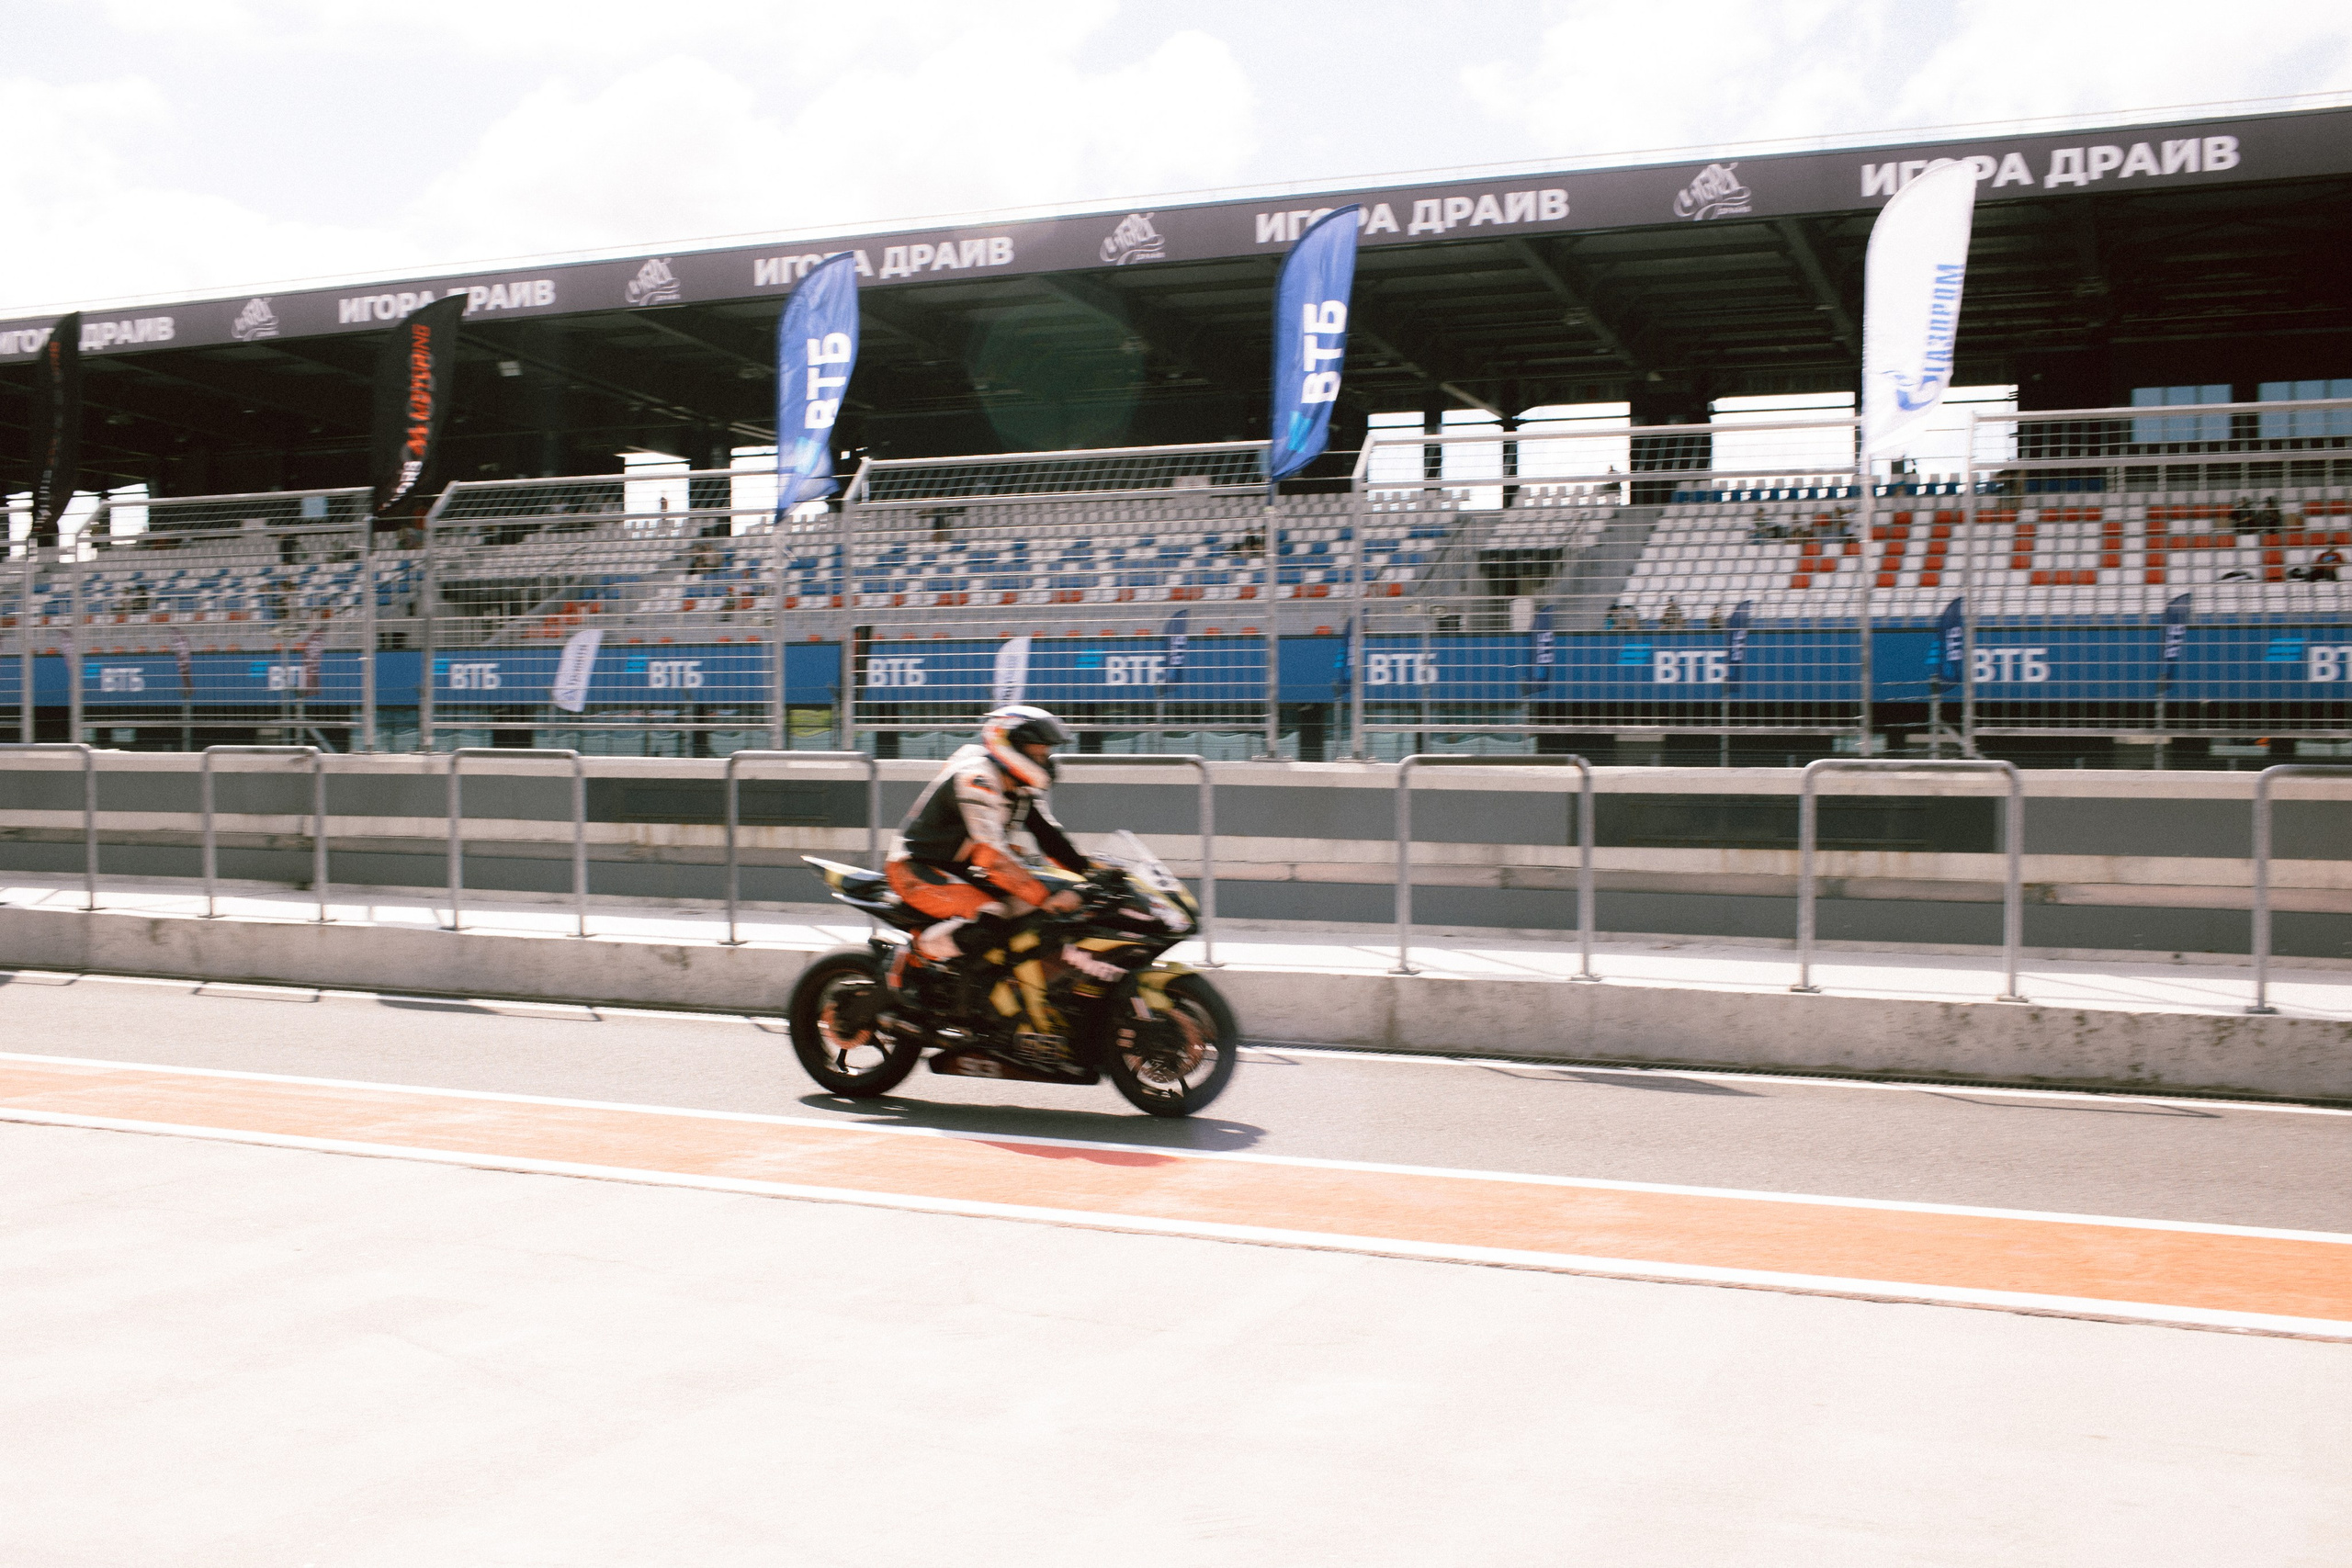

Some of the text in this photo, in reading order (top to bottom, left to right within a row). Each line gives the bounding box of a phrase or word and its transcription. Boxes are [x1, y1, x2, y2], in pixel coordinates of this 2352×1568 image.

[1860, 135, 2241, 197] ИГРА ДРАЙВ
[1408, 189, 1570, 236] ДРАЙВ
[879, 236, 1014, 279] ДРАЙВ
[1300, 299, 1348, 404] ВТБ
[804, 332, 852, 429] ВТБ
[450, 663, 502, 690] ВТБ
[649, 660, 705, 688] ВТБ
[866, 658, 927, 687] ВТБ
[1367, 653, 1439, 685] ВТБ
[1655, 650, 1729, 683] ВТБ
[1971, 648, 2051, 682] ВТБ
